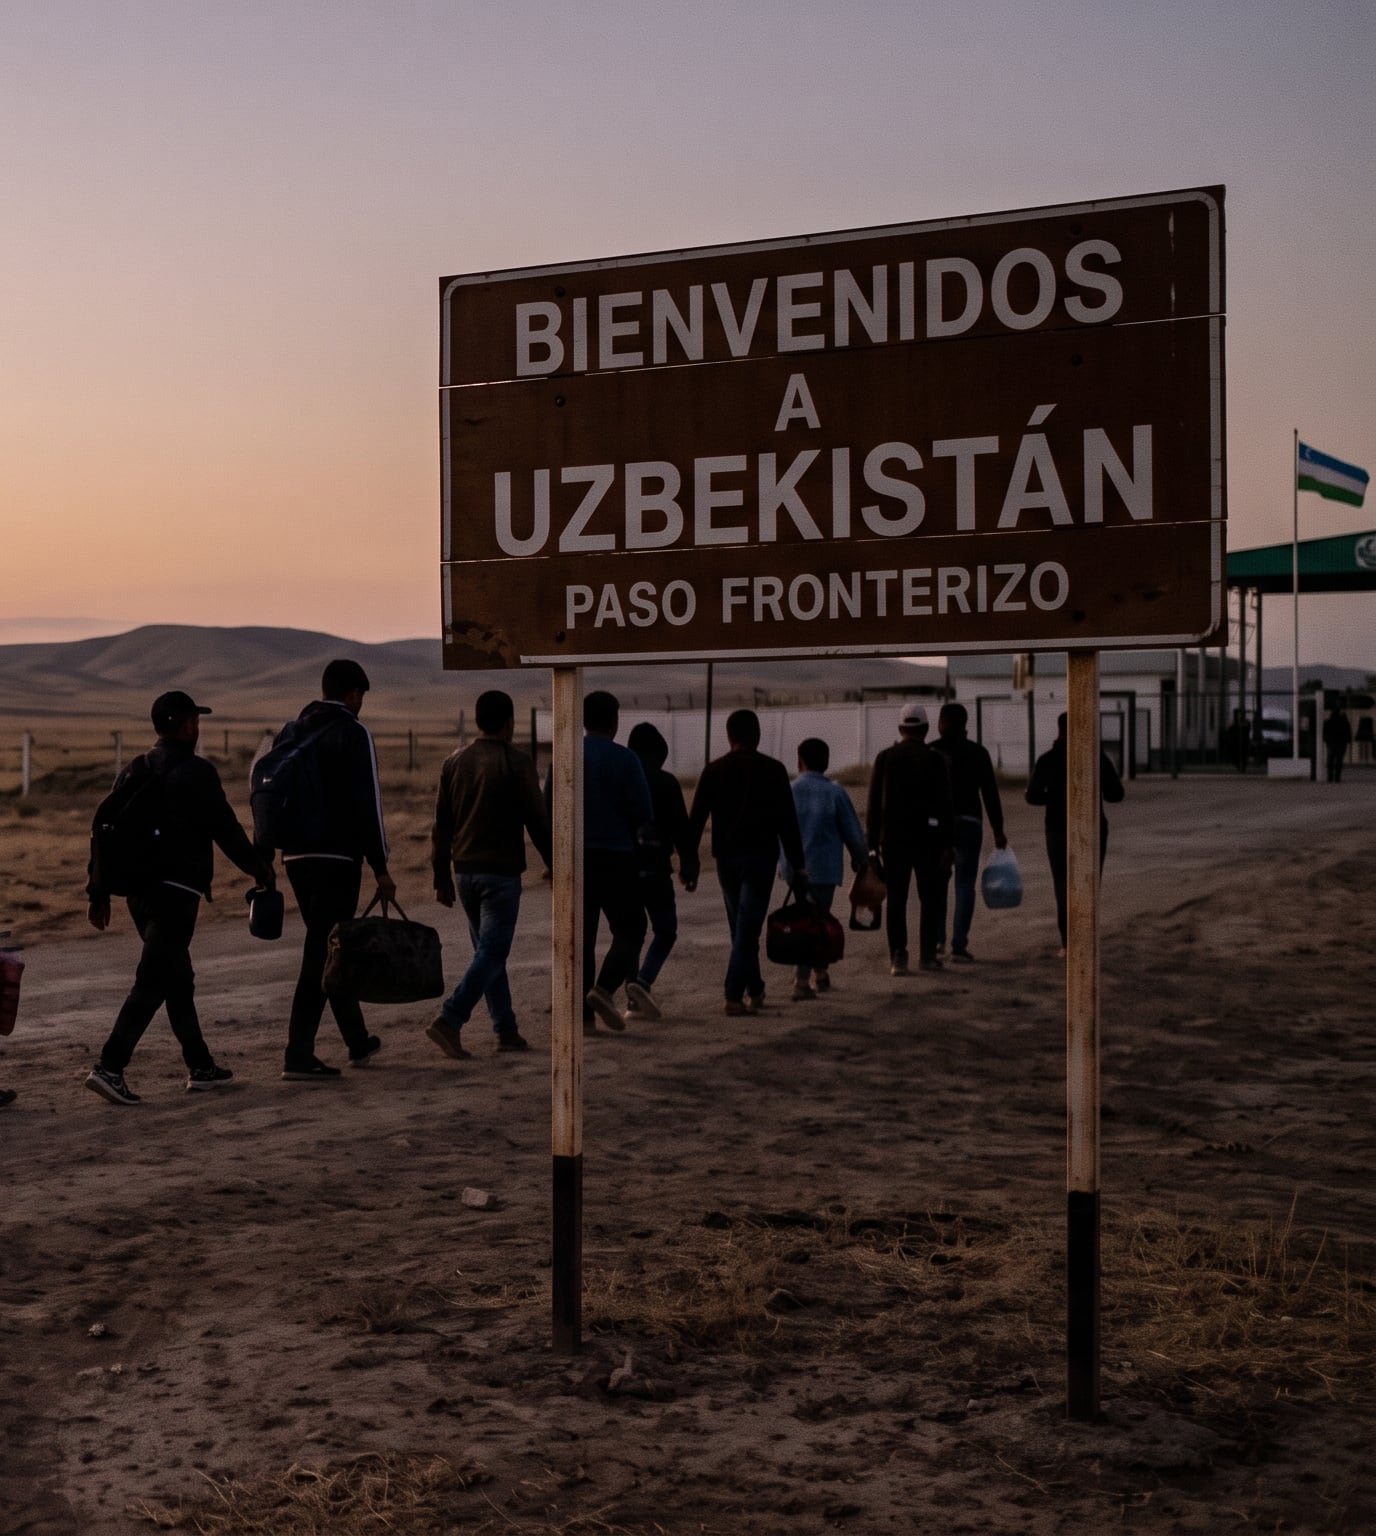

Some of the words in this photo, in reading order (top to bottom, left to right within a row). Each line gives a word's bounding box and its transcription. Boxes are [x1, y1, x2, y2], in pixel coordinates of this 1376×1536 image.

[516, 240, 1123, 377] BIENVENIDOS
[774, 373, 821, 432] A
[494, 404, 1153, 557] UZBEKISTÁN
[566, 579, 696, 629] PASO
[722, 561, 1070, 623] FRONTERIZO
